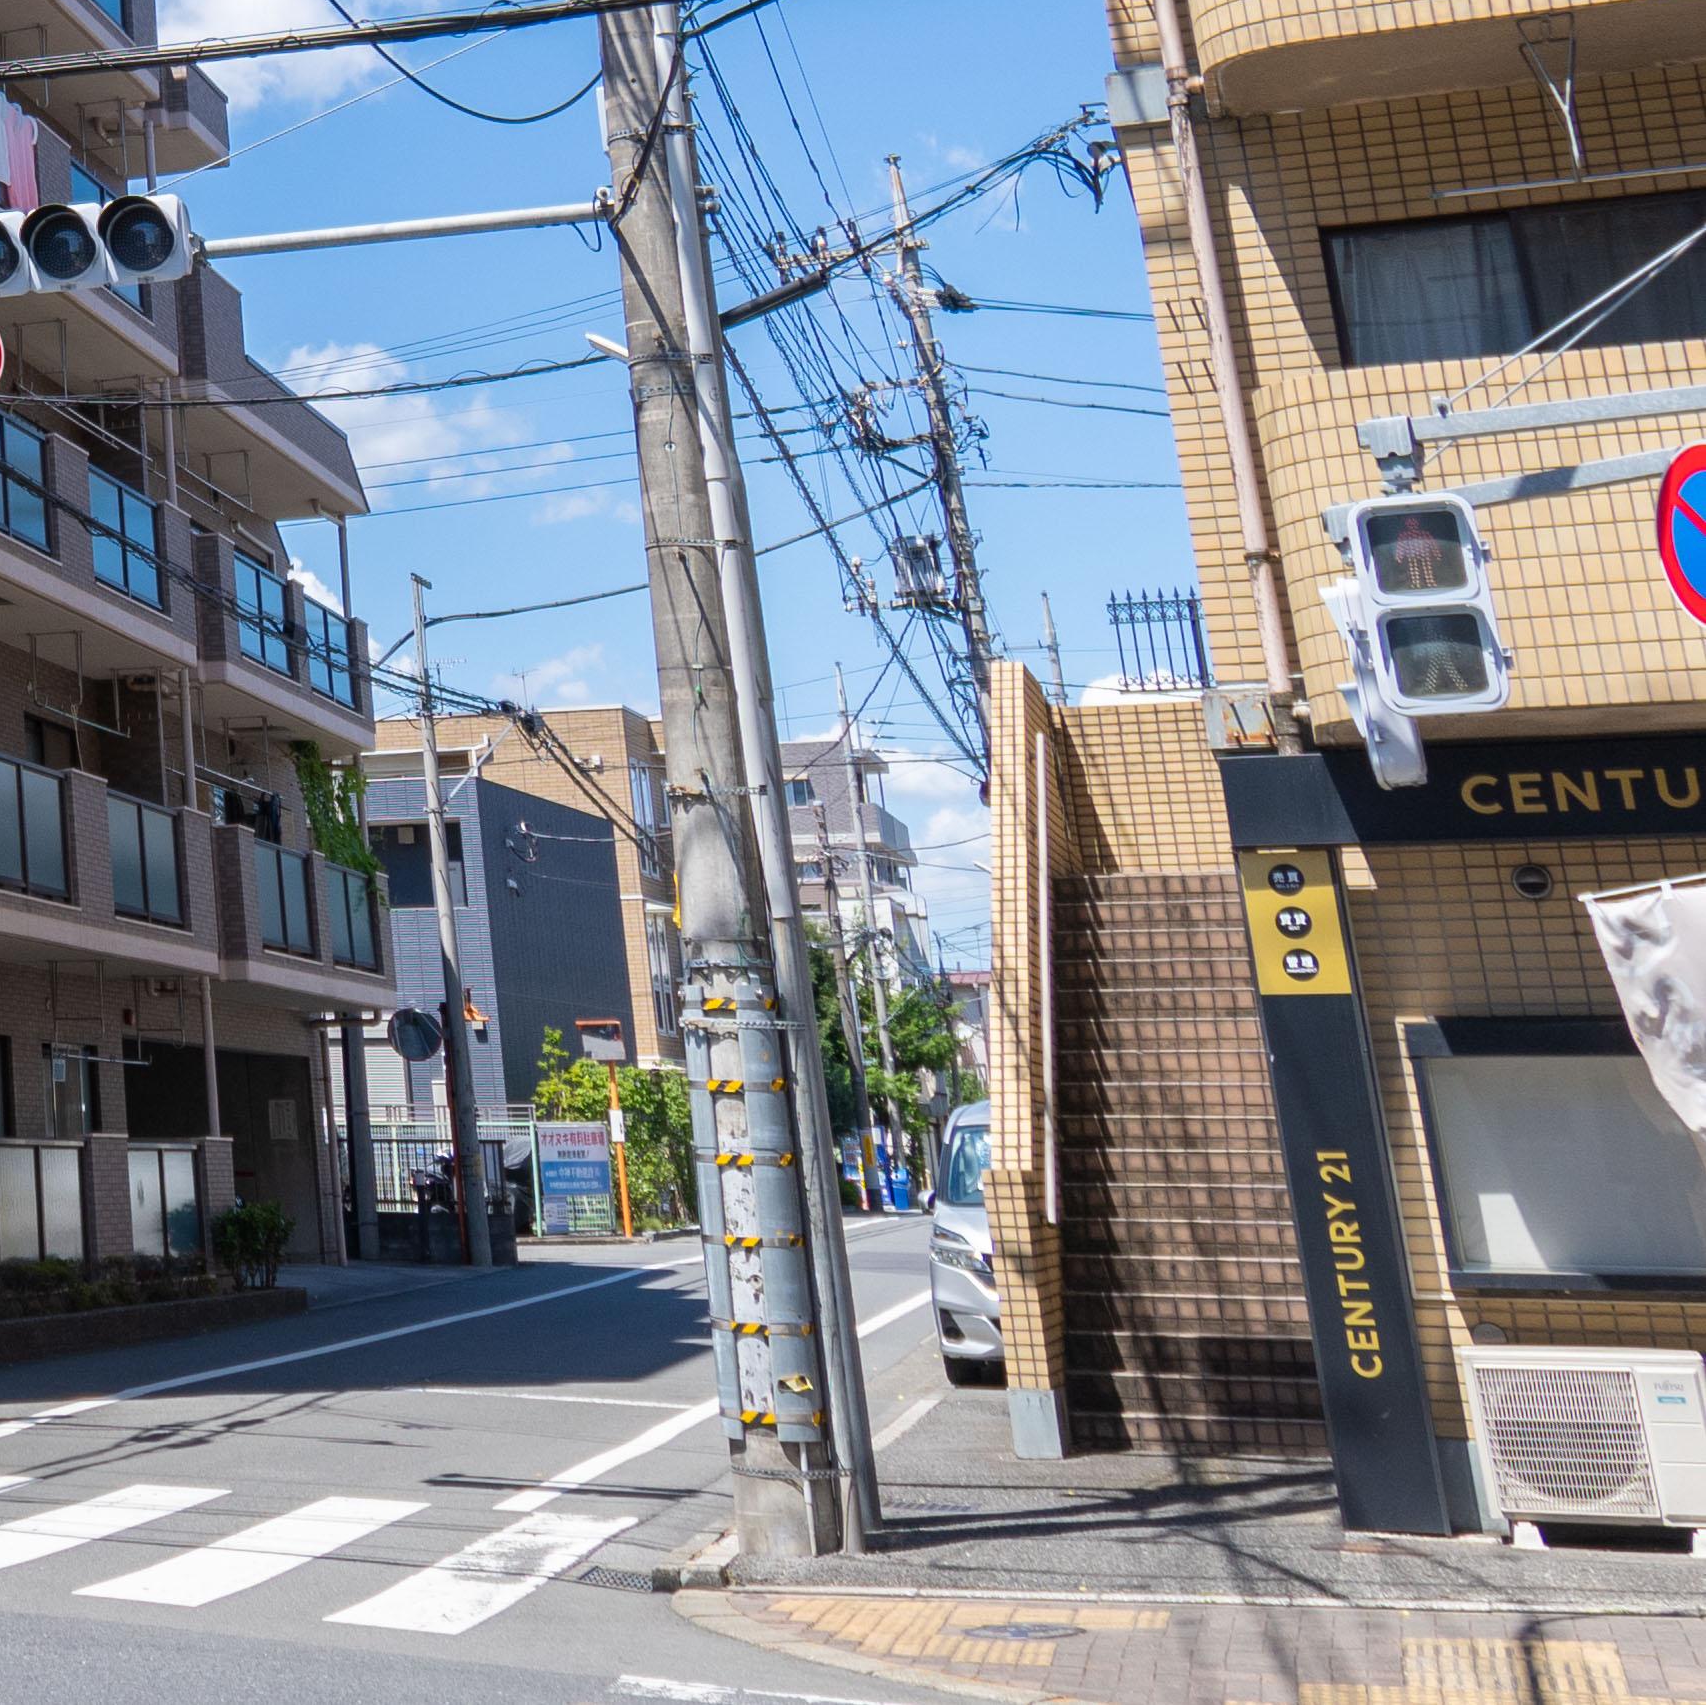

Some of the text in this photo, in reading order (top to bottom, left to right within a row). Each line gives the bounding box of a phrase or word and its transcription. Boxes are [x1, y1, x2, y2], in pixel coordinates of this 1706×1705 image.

[1460, 767, 1701, 814] CENTU
[1316, 1150, 1383, 1379] CENTURY 21
